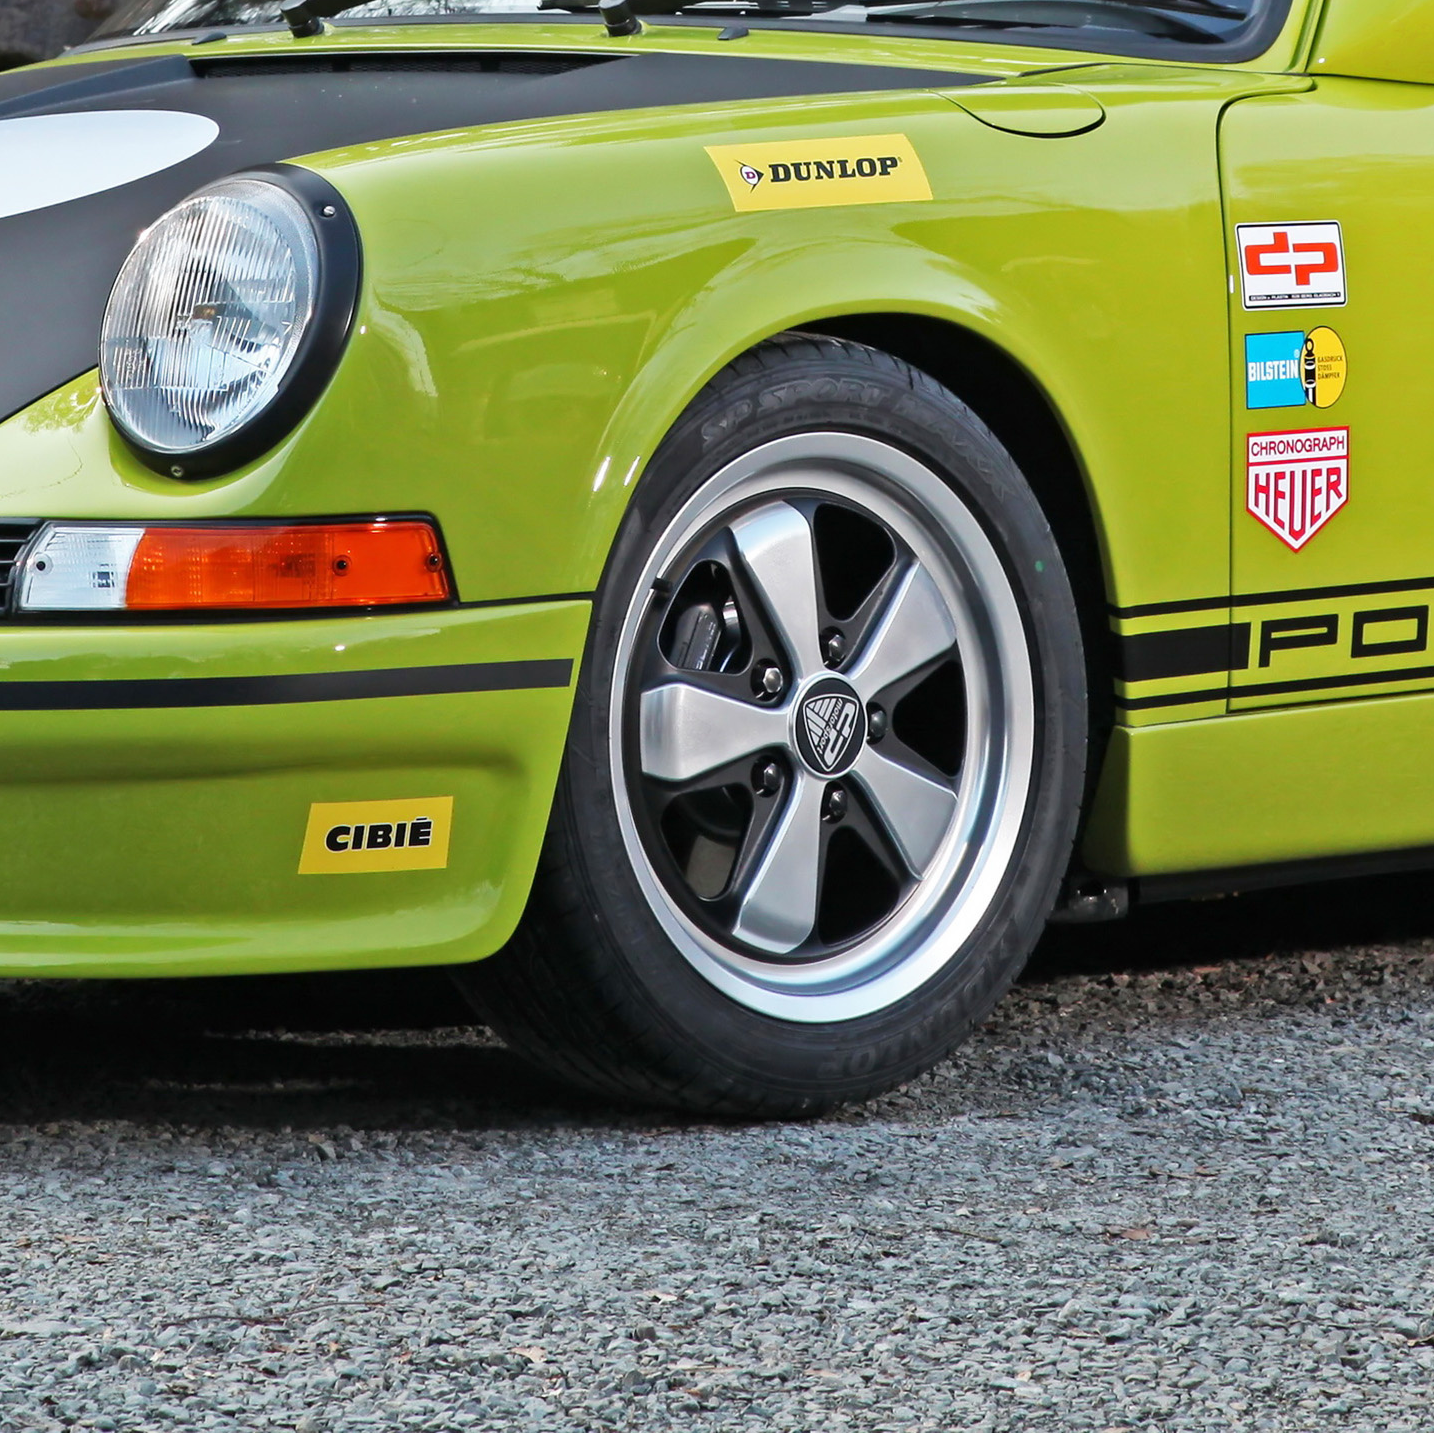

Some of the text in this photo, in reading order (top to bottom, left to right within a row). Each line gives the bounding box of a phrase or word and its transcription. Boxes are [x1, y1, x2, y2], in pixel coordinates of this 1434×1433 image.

[768, 156, 899, 183] DUNLOP
[1247, 359, 1300, 382] BILSTEIN
[756, 377, 895, 418] SPORT
[1251, 435, 1345, 457] CHRONOGRAPH
[1254, 467, 1344, 542] HEUER
